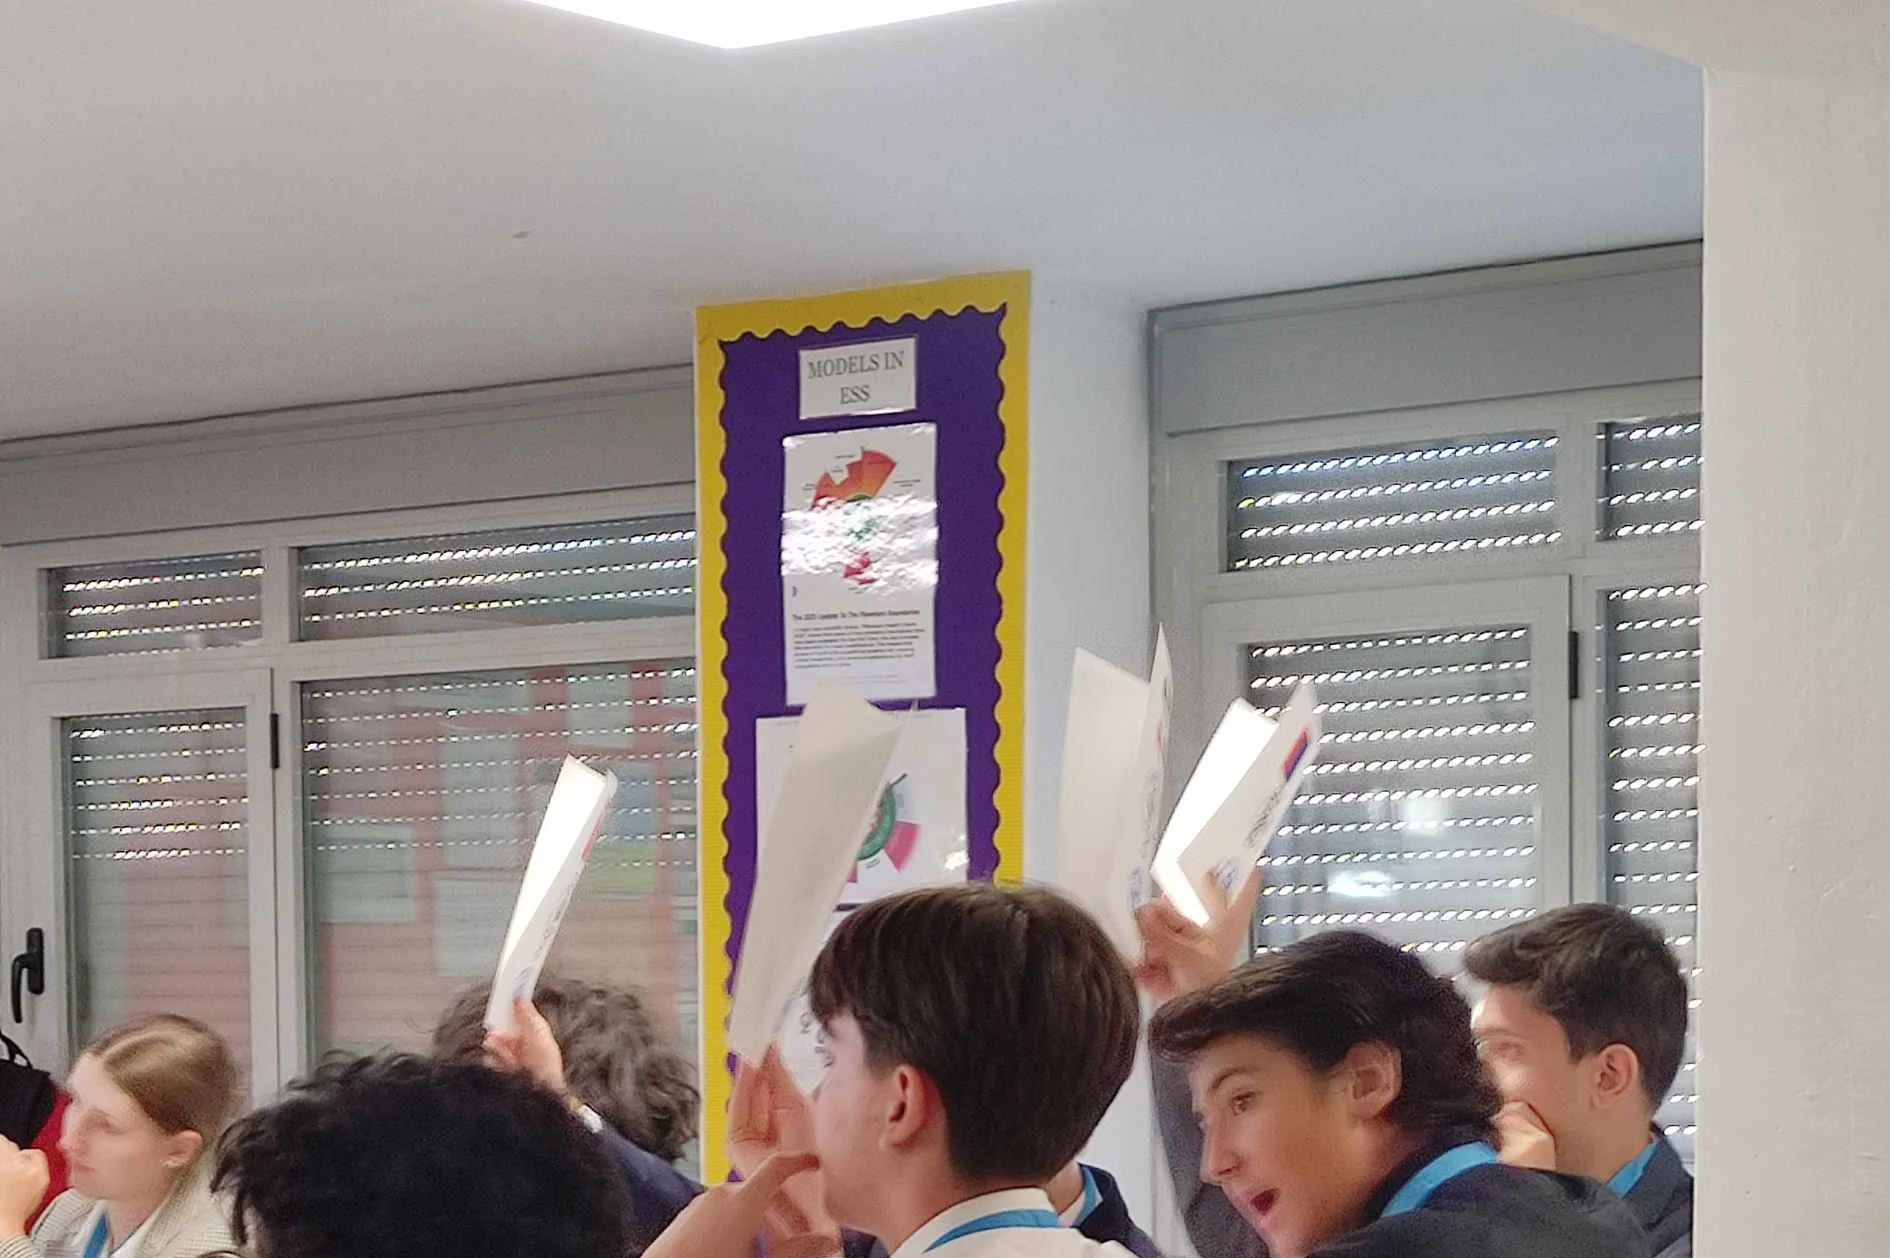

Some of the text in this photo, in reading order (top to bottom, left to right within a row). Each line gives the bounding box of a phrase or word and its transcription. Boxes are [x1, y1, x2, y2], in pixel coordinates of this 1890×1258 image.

[807, 350, 905, 379] MODELS IN
[840, 384, 871, 405] ESS
